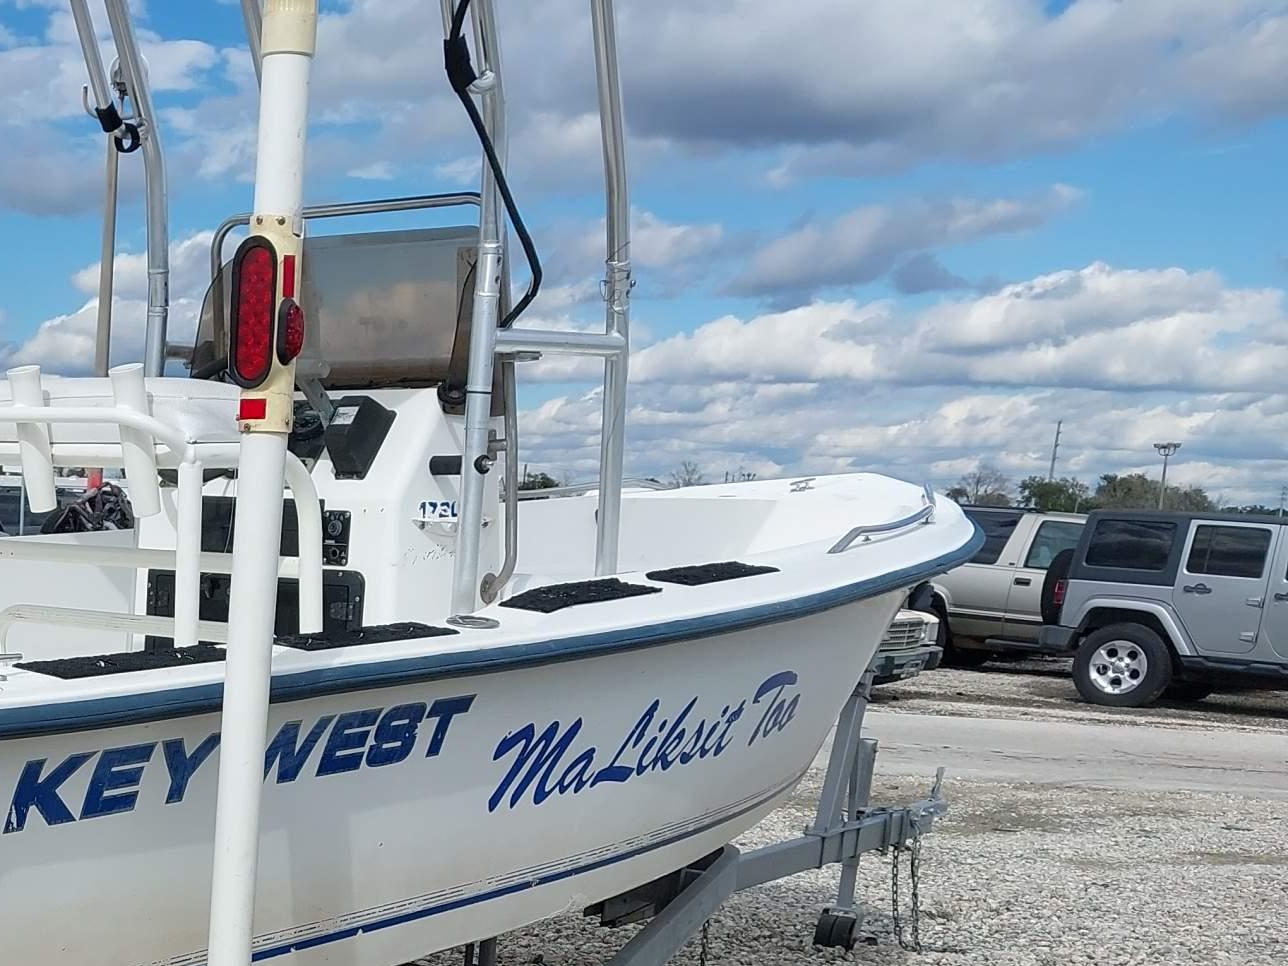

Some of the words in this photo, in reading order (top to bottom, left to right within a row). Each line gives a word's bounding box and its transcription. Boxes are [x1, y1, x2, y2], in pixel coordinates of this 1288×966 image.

[748, 670, 802, 747] Too
[2, 732, 221, 835] KEY
[263, 693, 477, 785] WEST
